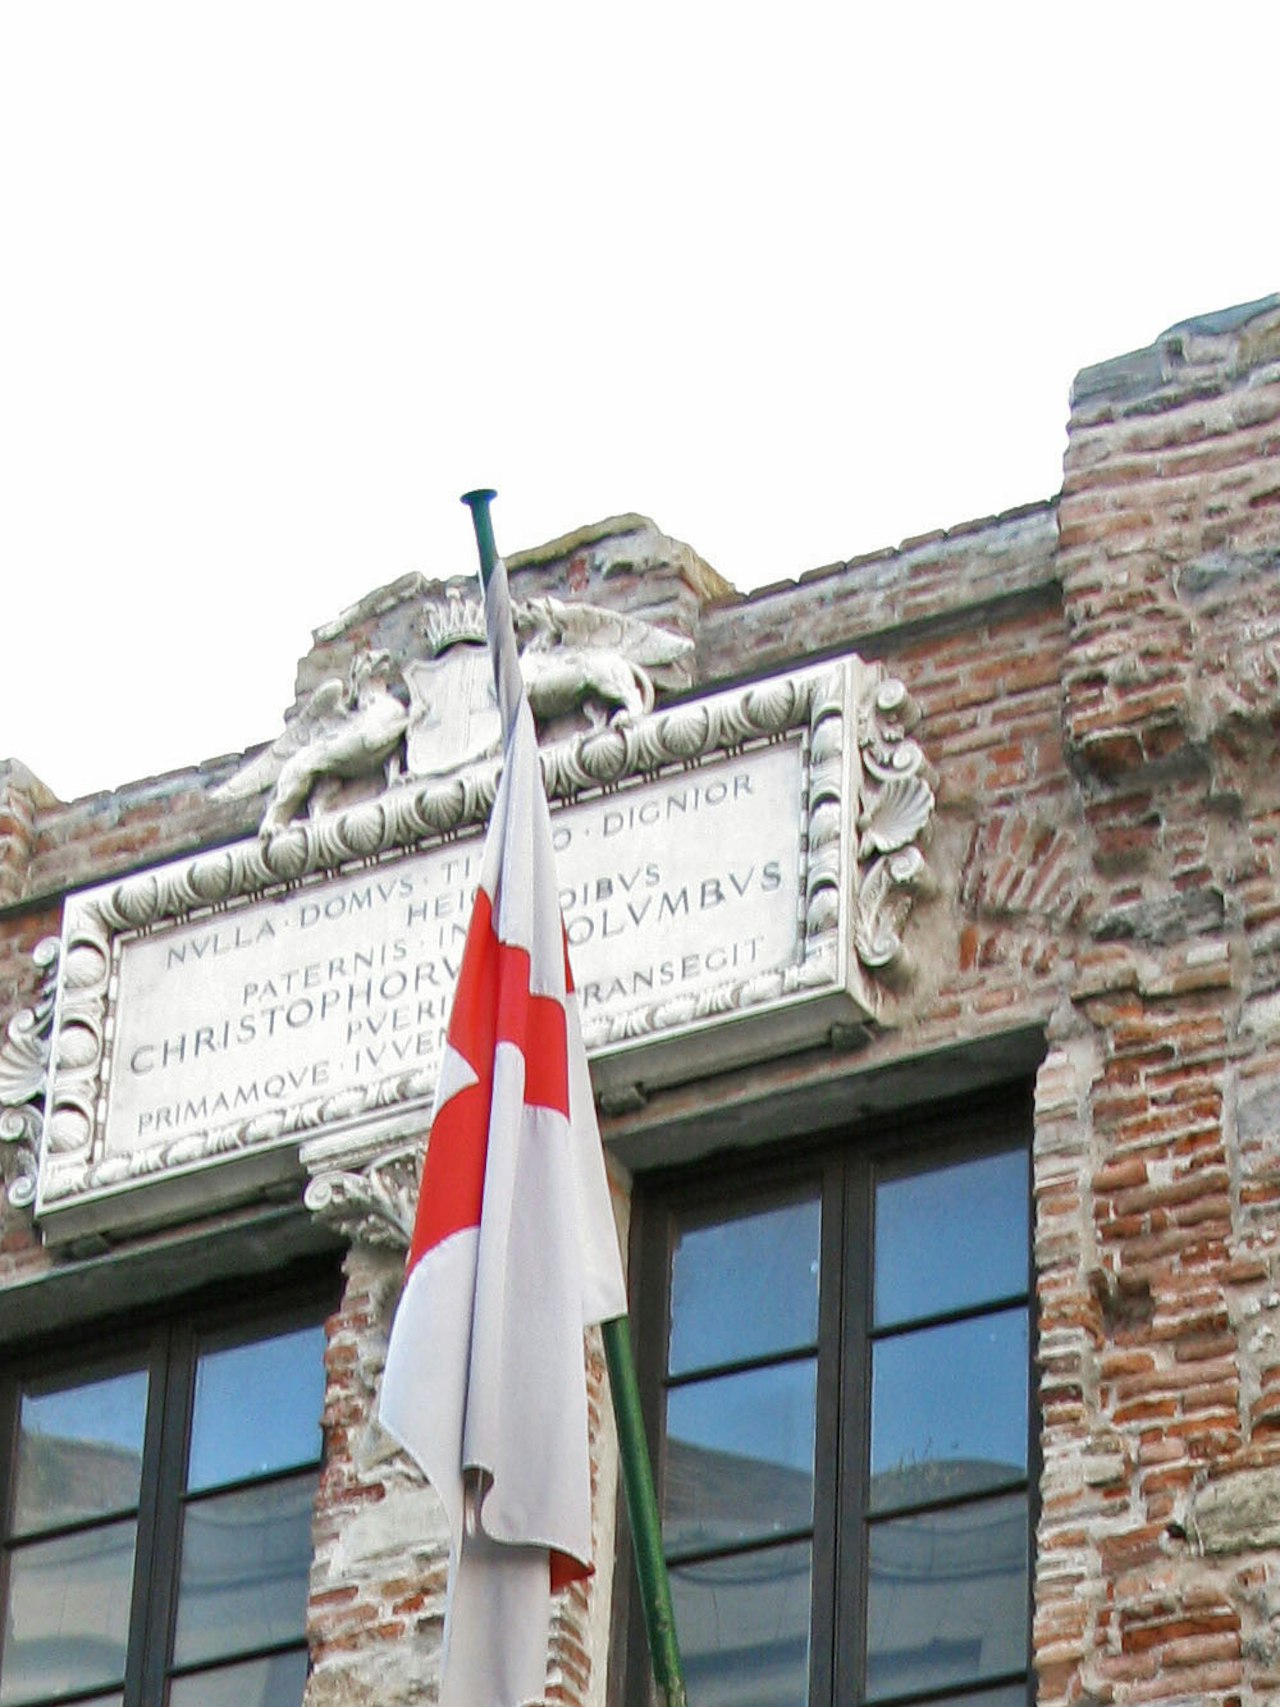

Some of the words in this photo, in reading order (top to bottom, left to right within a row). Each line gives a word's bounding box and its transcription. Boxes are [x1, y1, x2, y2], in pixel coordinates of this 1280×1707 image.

[130, 956, 460, 1077] CHRISTOPHORV
[566, 861, 782, 946] OLVMBVS
[165, 918, 277, 970] NVLLA
[300, 875, 413, 928] DOMVS
[603, 773, 753, 838] DIGNIOR
[243, 938, 407, 1005] PATERNIS
[560, 863, 661, 911] DIBVS
[137, 1062, 330, 1136] PRIMAMQVE
[578, 935, 763, 1009] RANSEGIT
[347, 995, 445, 1045] PVERI
